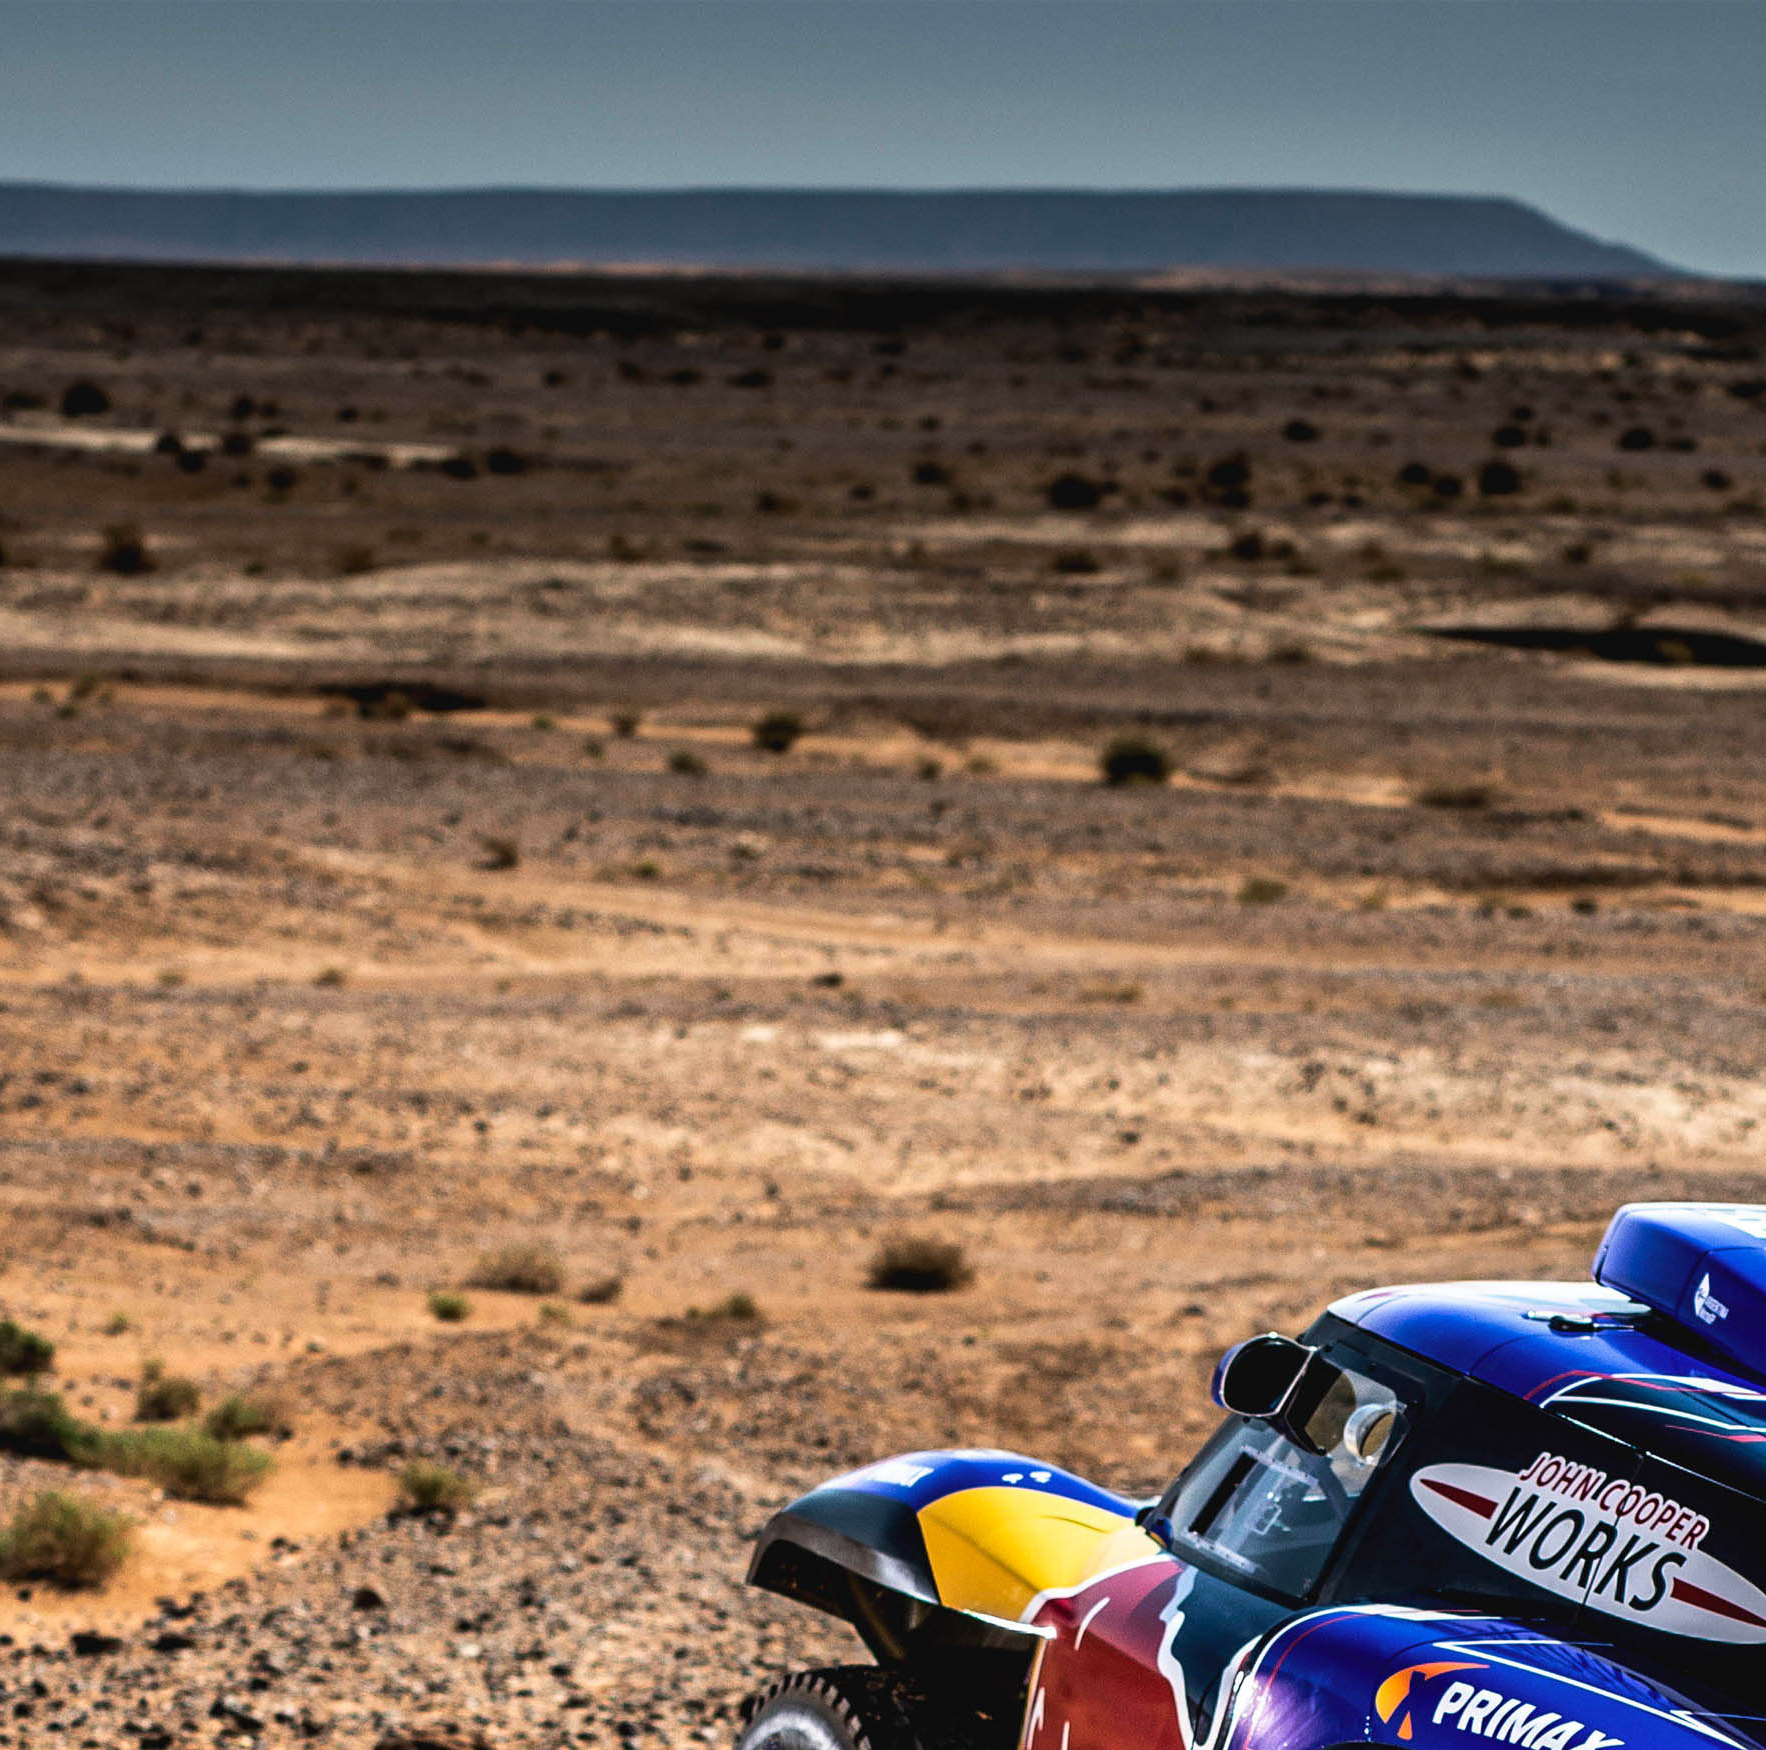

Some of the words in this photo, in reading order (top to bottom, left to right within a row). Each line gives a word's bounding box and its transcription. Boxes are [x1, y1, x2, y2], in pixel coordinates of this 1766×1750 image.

[1485, 1487, 1687, 1611] WORKS
[1519, 1455, 1604, 1501] JOHN
[1599, 1484, 1707, 1549] COOPER
